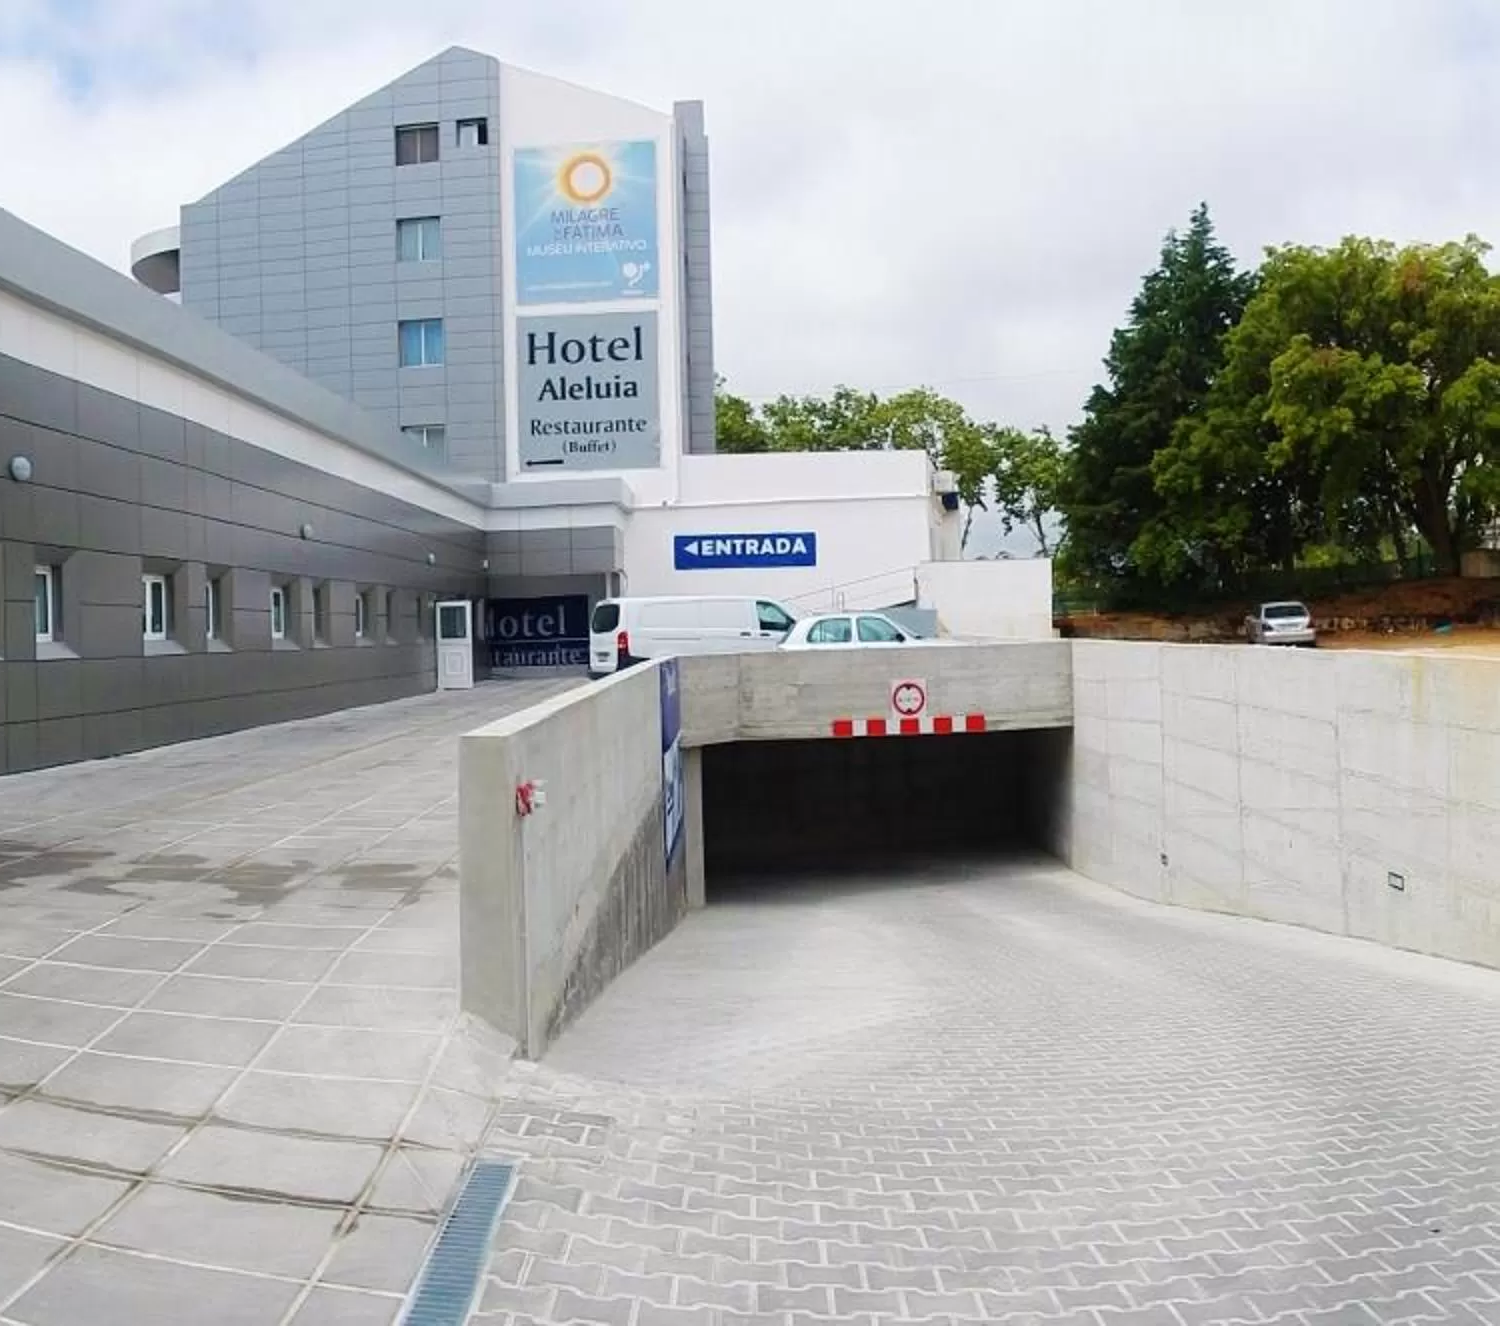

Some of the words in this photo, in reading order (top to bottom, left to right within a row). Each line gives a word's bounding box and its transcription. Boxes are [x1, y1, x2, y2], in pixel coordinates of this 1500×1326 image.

[551, 208, 620, 224] MILAGRE
[527, 243, 573, 256] MUSEU
[527, 326, 643, 365] Hotel
[537, 375, 638, 402] Aleluia
[531, 416, 647, 436] Restaurante
[562, 440, 617, 454] (Buffet)
[701, 537, 807, 556] ENTRADA
[493, 646, 581, 666] taurante
